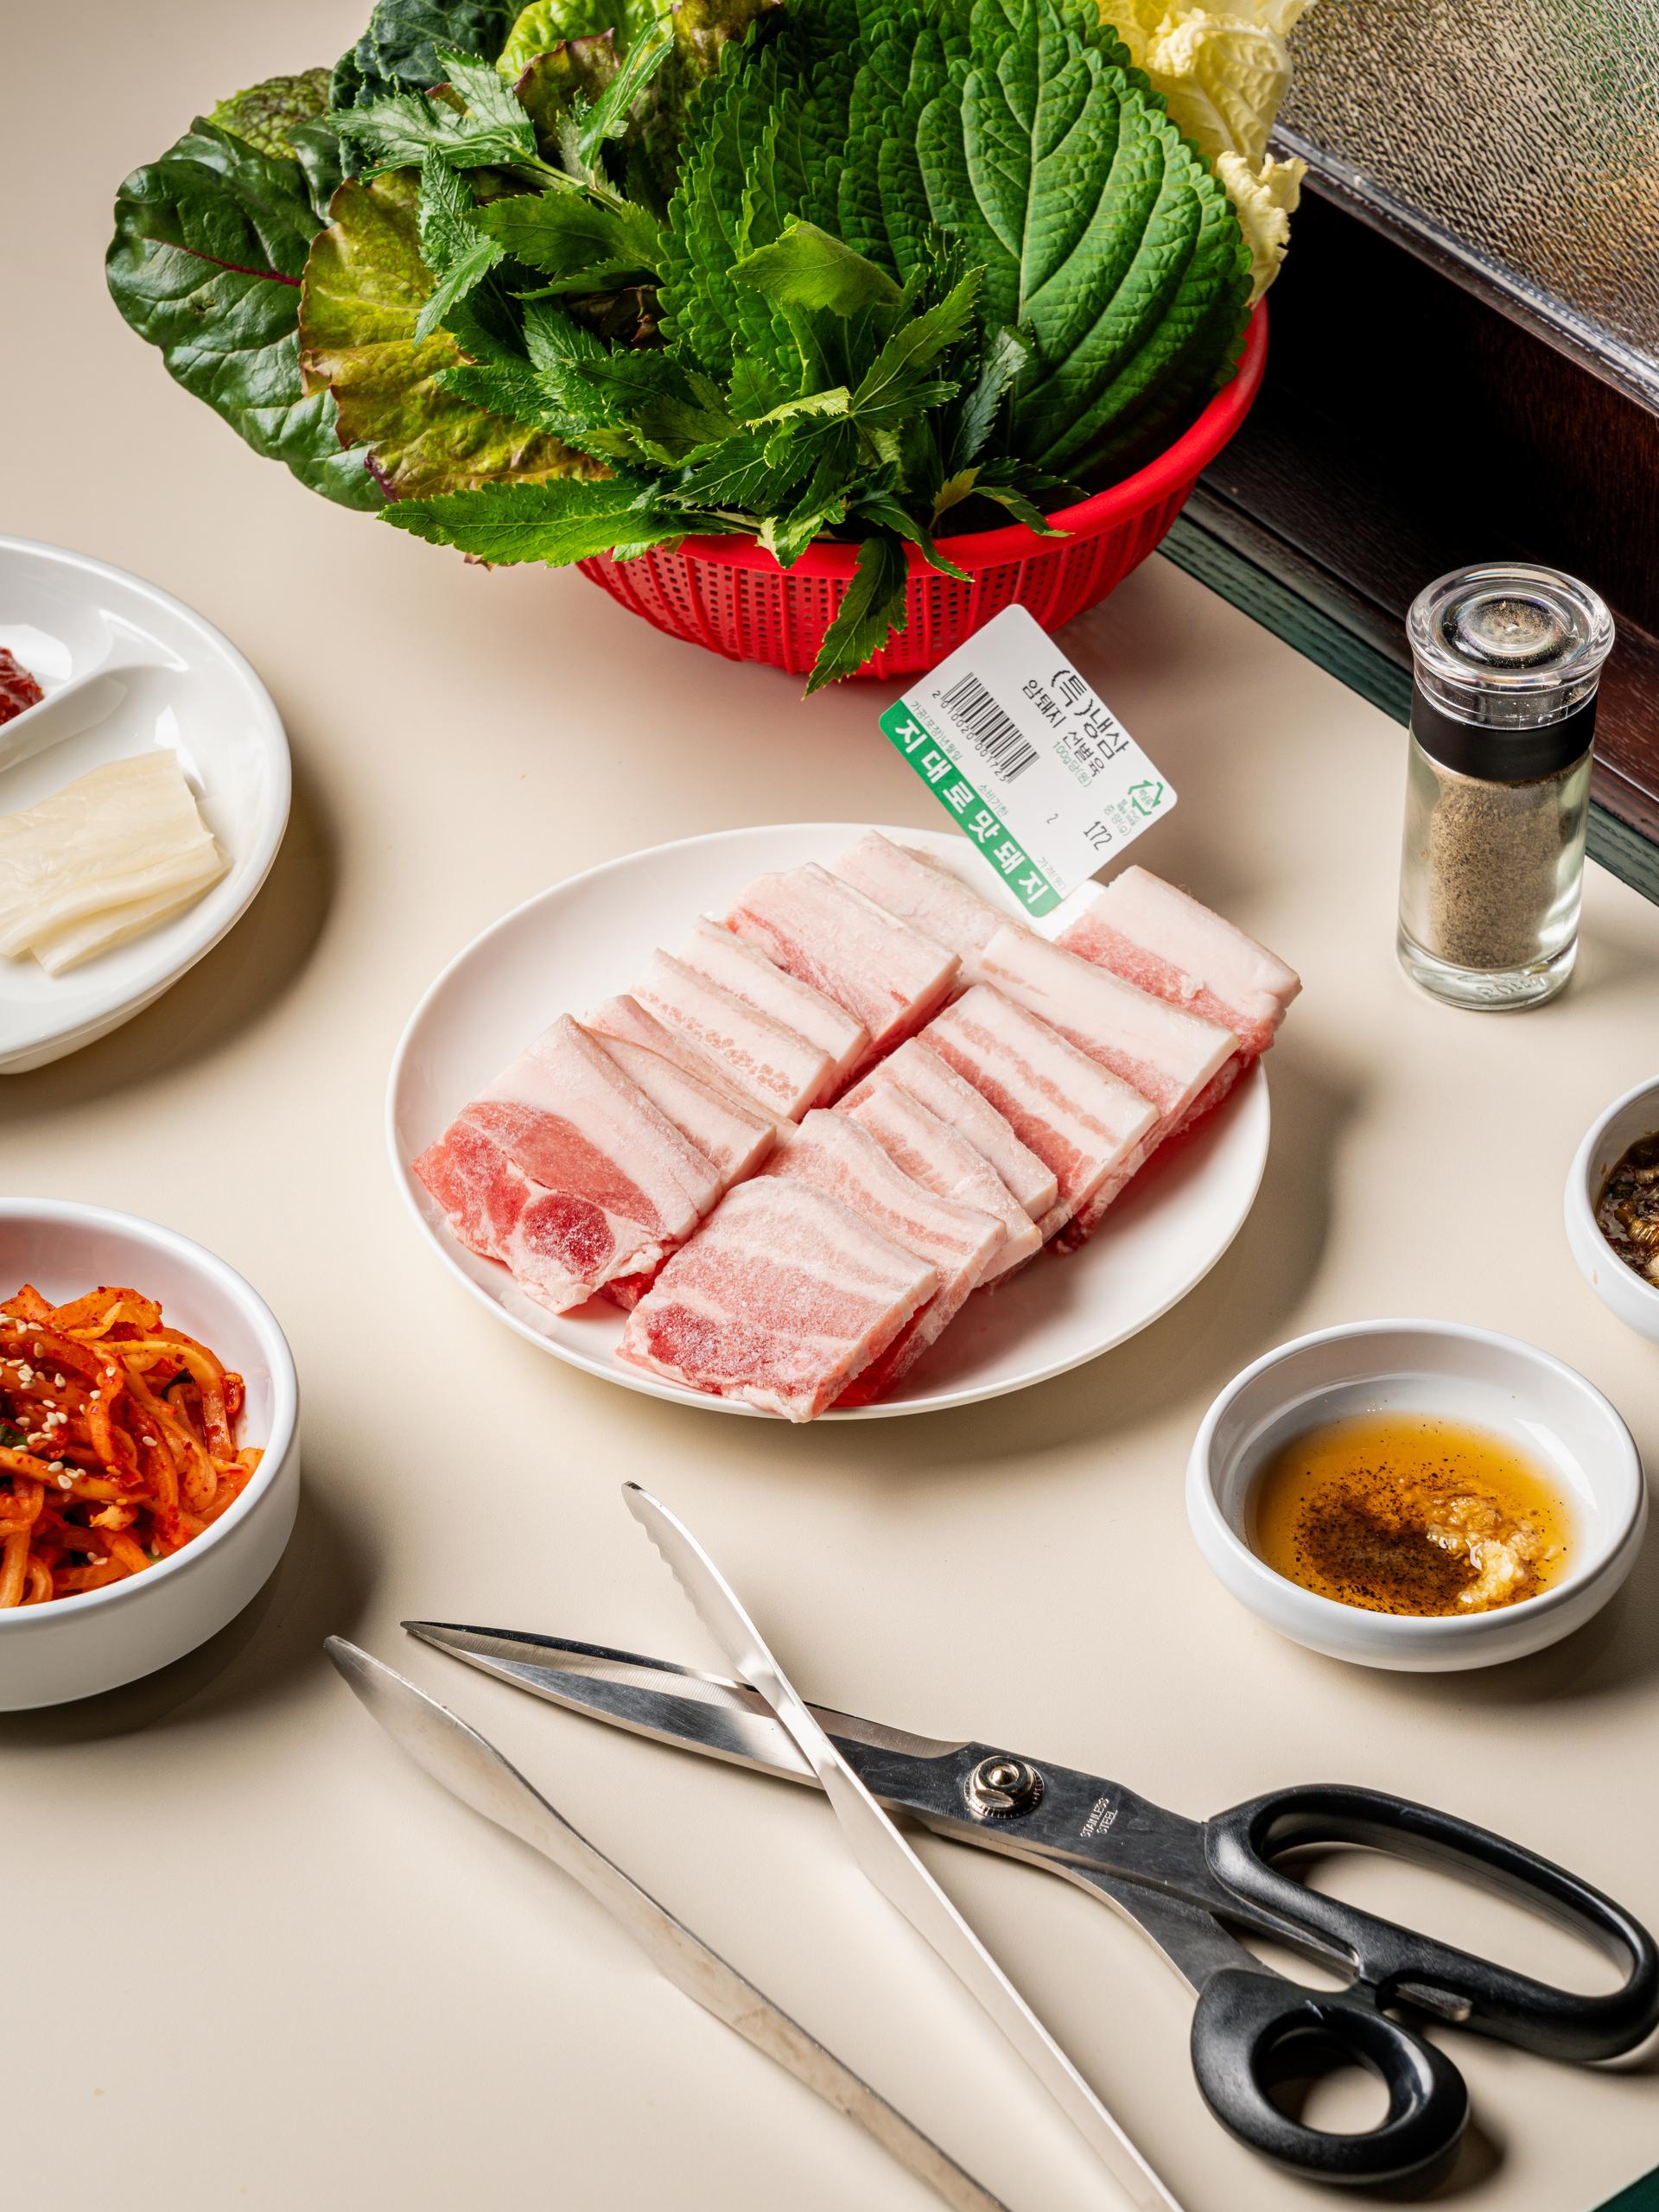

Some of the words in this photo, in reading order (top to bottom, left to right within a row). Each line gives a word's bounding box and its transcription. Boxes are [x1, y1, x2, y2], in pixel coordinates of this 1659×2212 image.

[1021, 678, 1067, 728] 암퇘지
[1062, 729, 1107, 778] 선별육
[1049, 668, 1132, 761] (특)냉삼
[1084, 820, 1112, 850] 172
[1080, 1797, 1109, 1837] STAINLESS
[1096, 1809, 1118, 1834] STEEL
